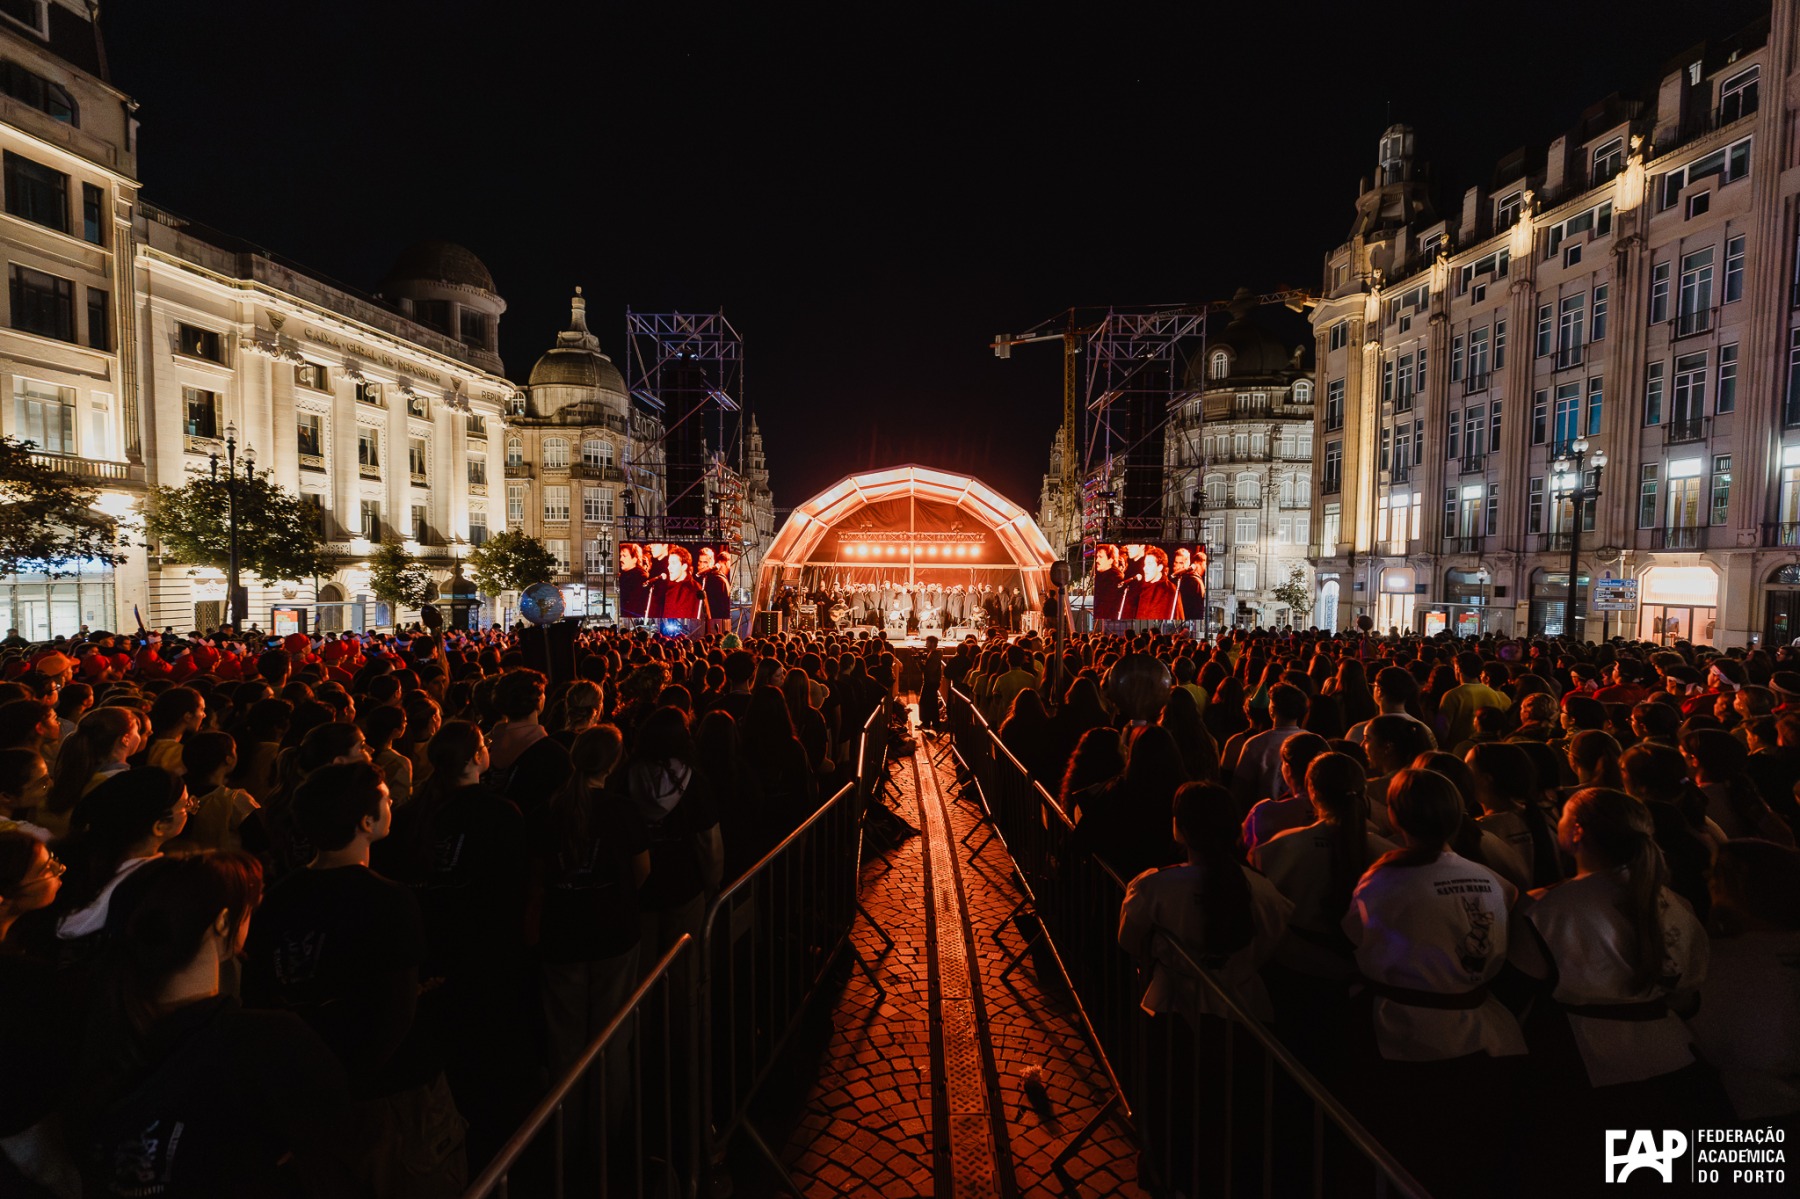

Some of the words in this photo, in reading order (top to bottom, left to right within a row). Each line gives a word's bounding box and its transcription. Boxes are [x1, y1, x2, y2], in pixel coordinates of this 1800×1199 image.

[304, 327, 341, 348] CAIXA
[347, 342, 378, 361] GERAL
[382, 353, 394, 367] DE
[1437, 886, 1465, 895] SANTA
[1466, 885, 1492, 893] MARIA
